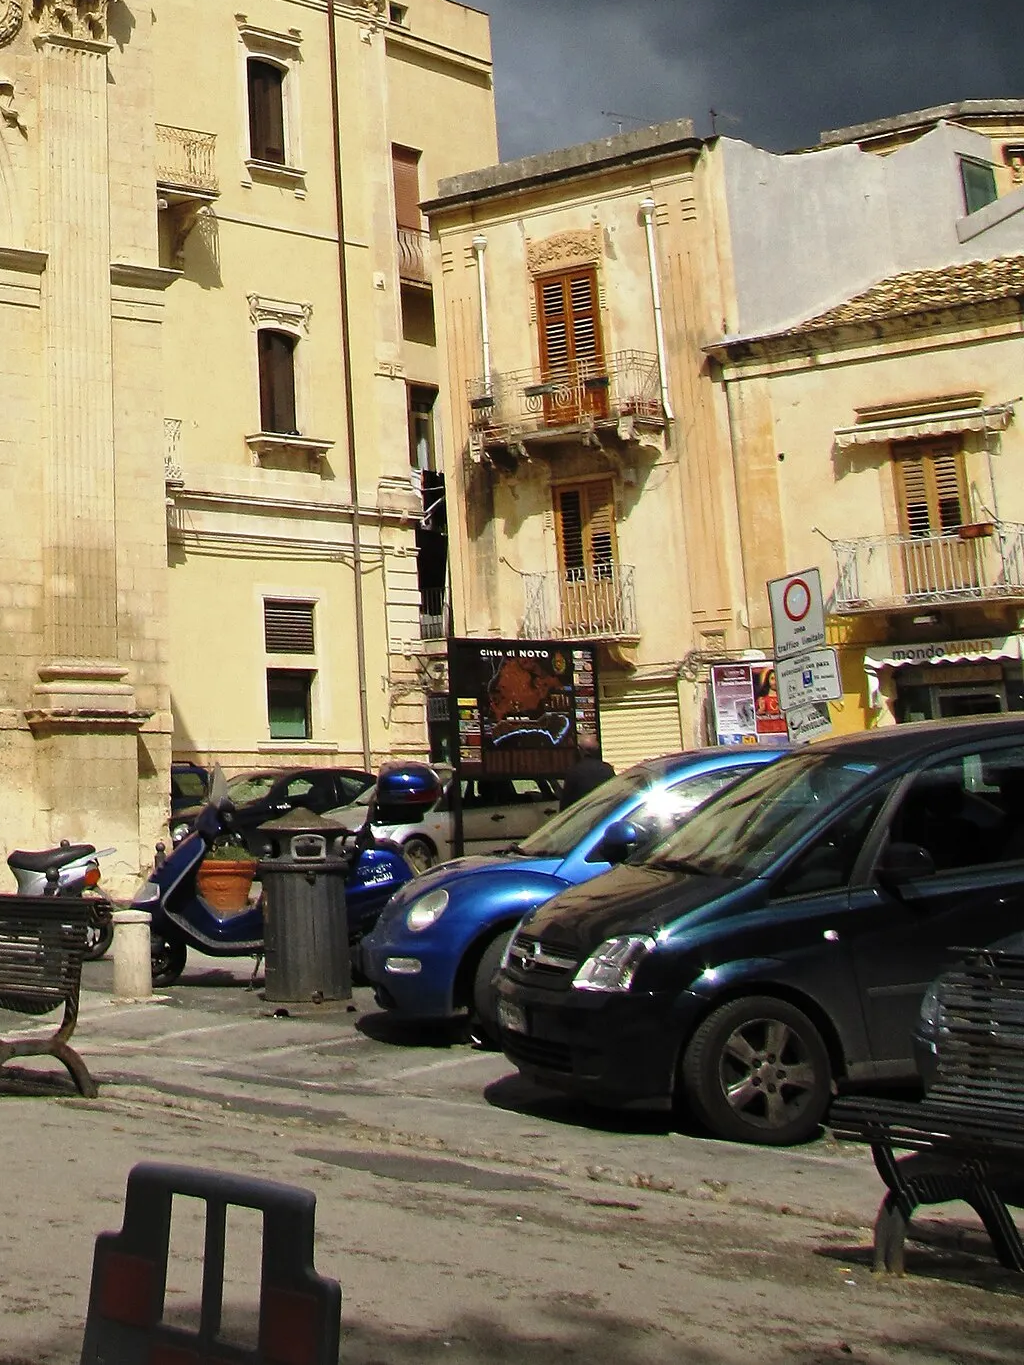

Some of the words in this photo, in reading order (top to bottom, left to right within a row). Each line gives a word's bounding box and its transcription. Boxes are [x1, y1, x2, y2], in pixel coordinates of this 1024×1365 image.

[777, 640, 800, 653] traffico
[801, 633, 824, 645] limitato
[892, 640, 992, 660] mondoWIND
[480, 649, 503, 657] Città
[506, 649, 515, 657] di
[519, 650, 549, 658] NOTO
